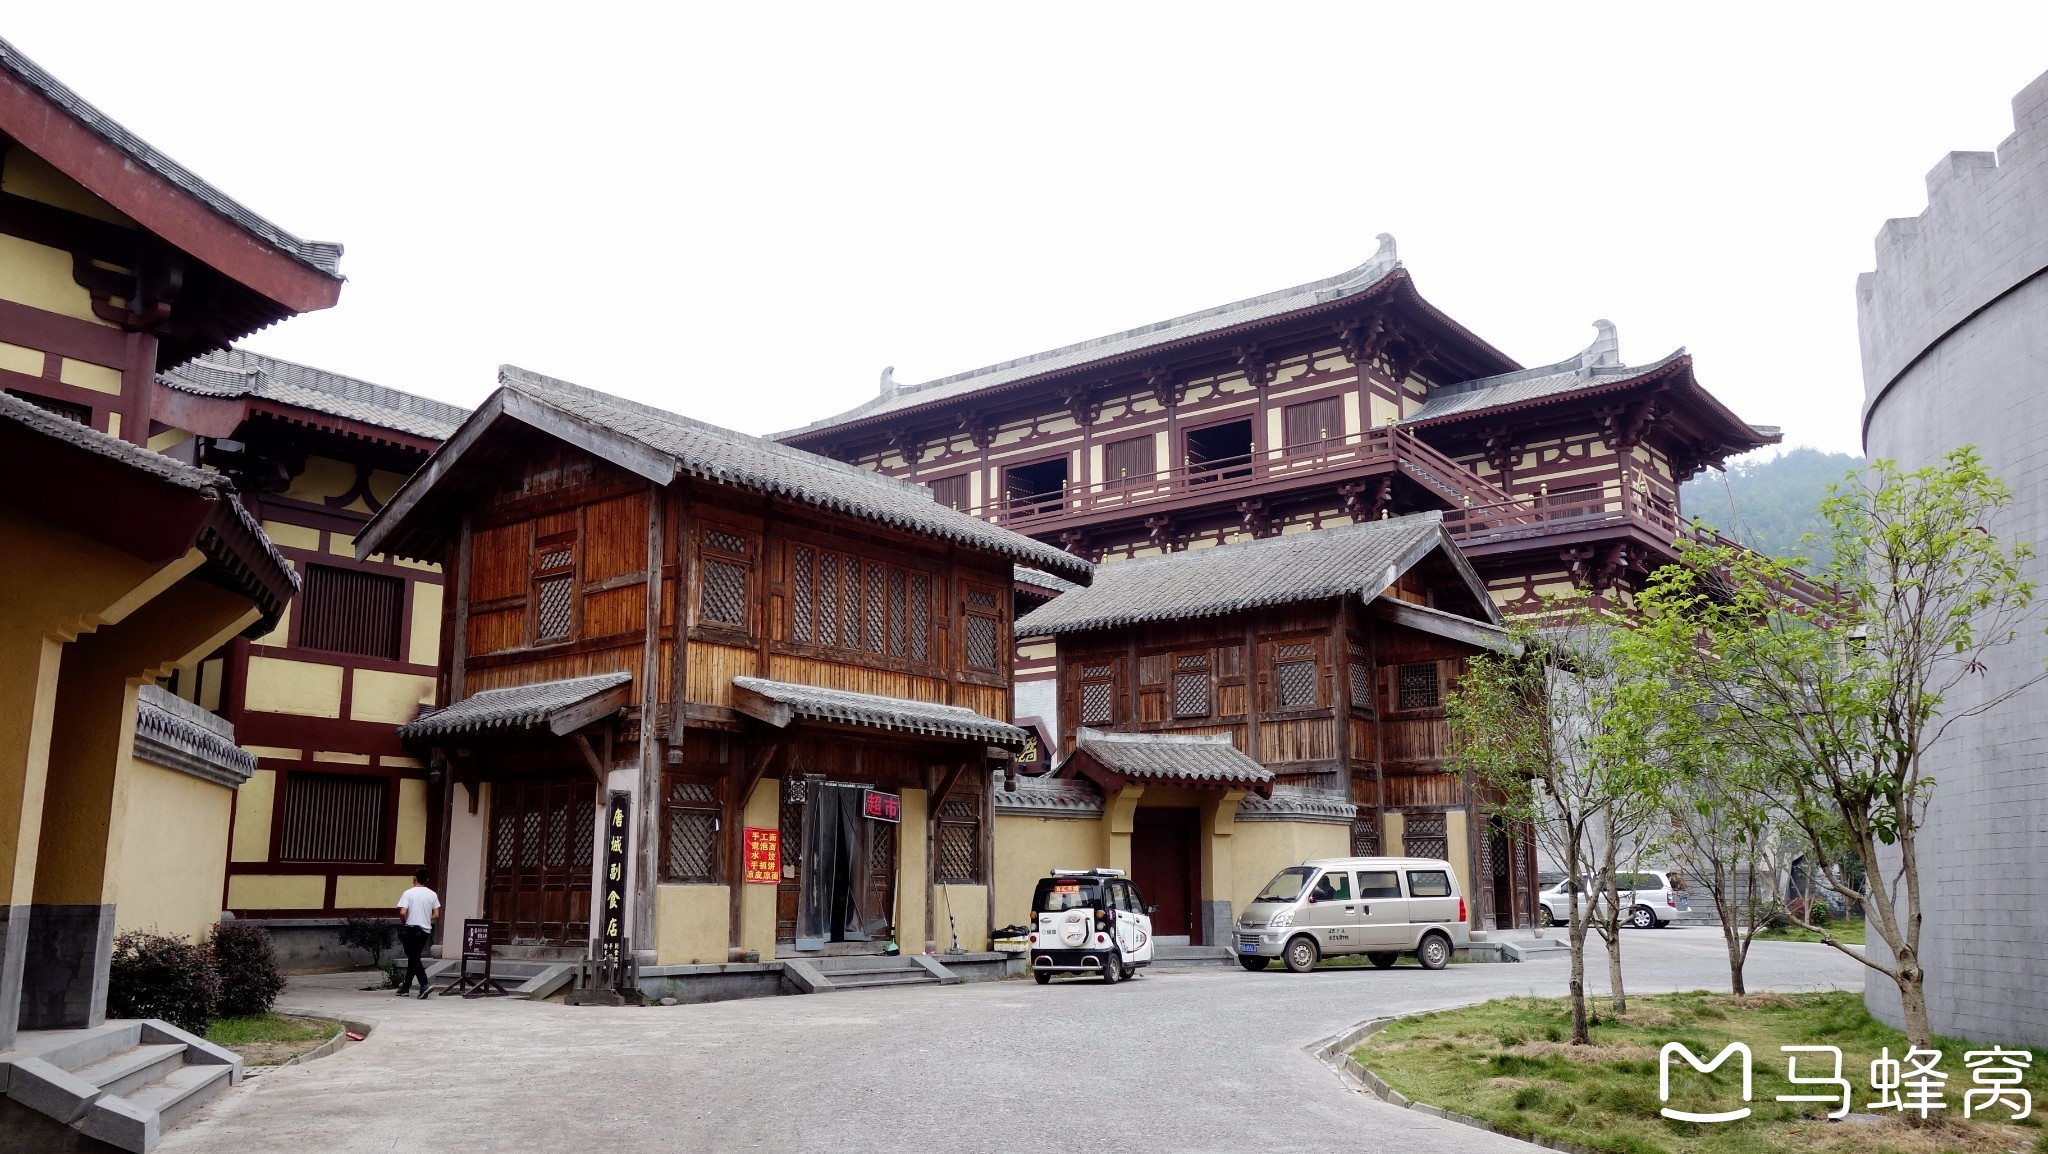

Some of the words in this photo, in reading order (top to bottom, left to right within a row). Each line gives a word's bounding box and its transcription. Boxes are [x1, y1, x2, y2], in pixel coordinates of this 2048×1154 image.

[867, 793, 897, 818] 超市
[751, 831, 777, 841] 手工面
[606, 807, 625, 938] 唐城副食店
[750, 861, 776, 871] 手抓饼
